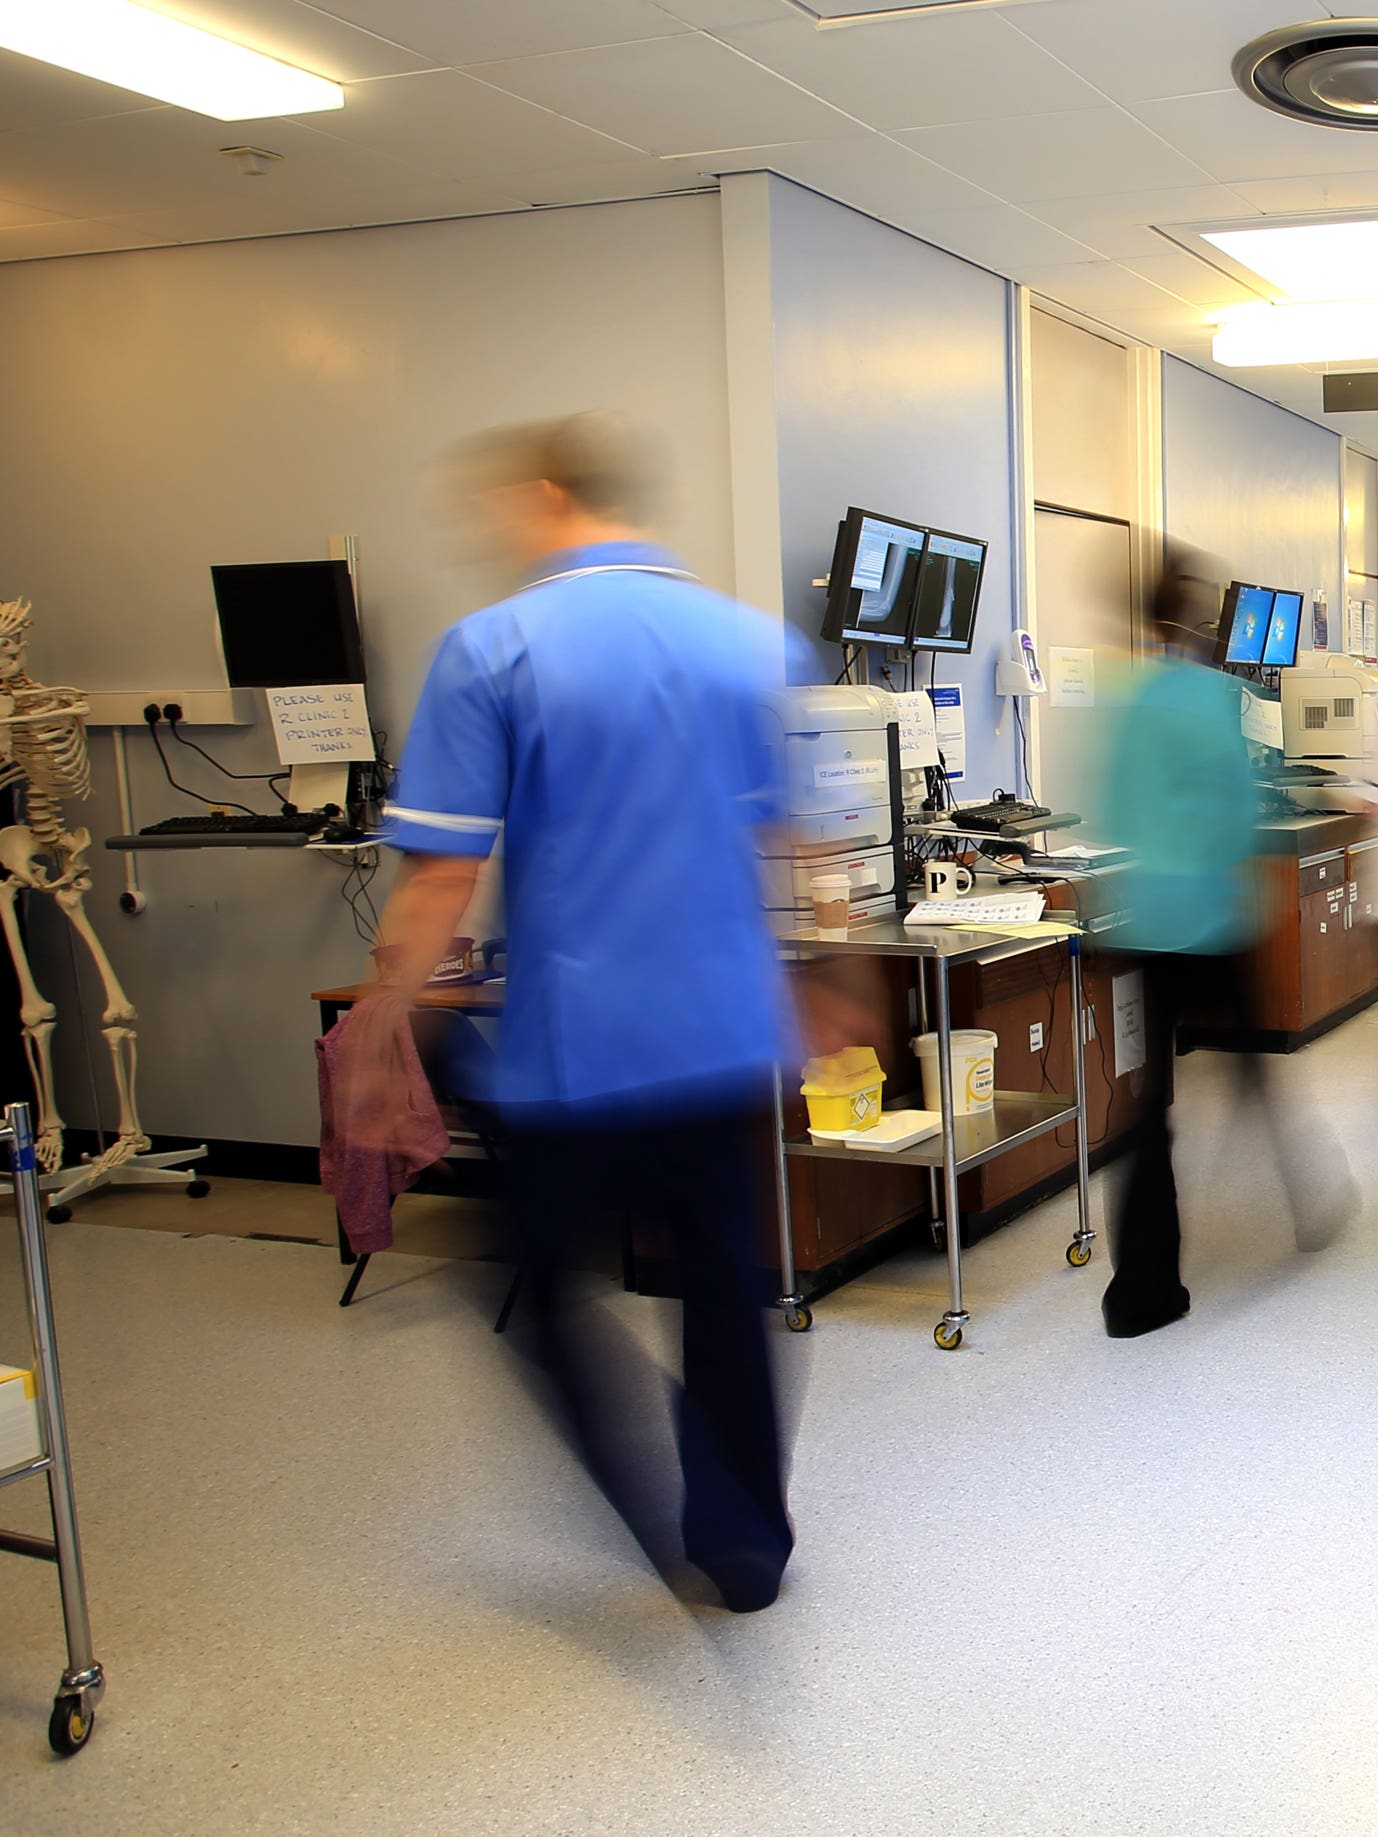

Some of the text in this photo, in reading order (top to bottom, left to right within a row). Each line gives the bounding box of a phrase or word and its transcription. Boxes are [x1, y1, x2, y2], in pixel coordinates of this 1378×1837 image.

[273, 693, 354, 707] PLEASE USE
[297, 710, 337, 722] CLINIC
[915, 712, 921, 722] 2
[286, 728, 343, 740] PRINTER
[312, 742, 352, 752] THANKS
[930, 872, 947, 893] P
